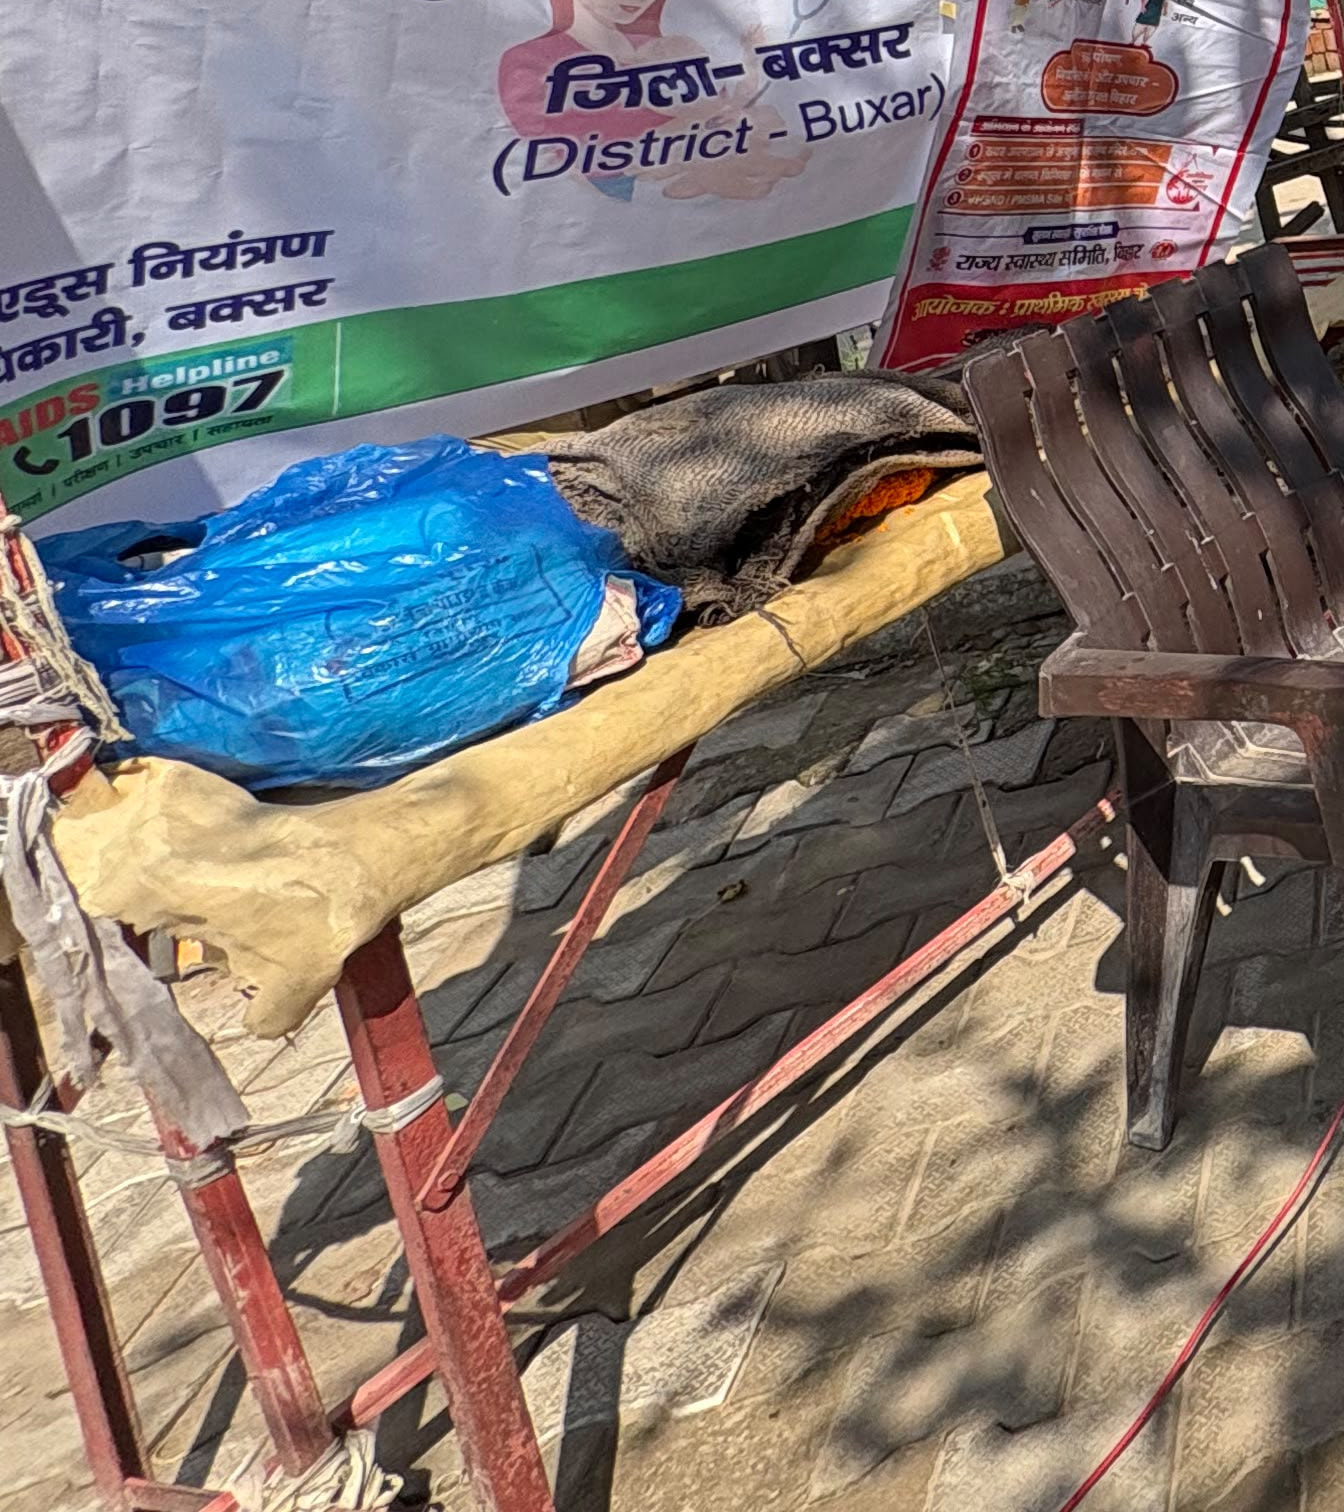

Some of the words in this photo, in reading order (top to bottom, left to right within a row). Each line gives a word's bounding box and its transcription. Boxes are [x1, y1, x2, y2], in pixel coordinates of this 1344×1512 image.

[755, 21, 915, 82] बक्सर
[492, 117, 755, 197] (District
[799, 73, 946, 145] Buxar)
[128, 230, 335, 288] नियंत्रण
[955, 251, 1000, 273] राज्य
[165, 278, 335, 332] बक्सर
[912, 294, 994, 322] आयोजक
[1010, 291, 1086, 319] प्राथमिक
[121, 348, 281, 396] Helpline
[57, 369, 286, 462] 1097
